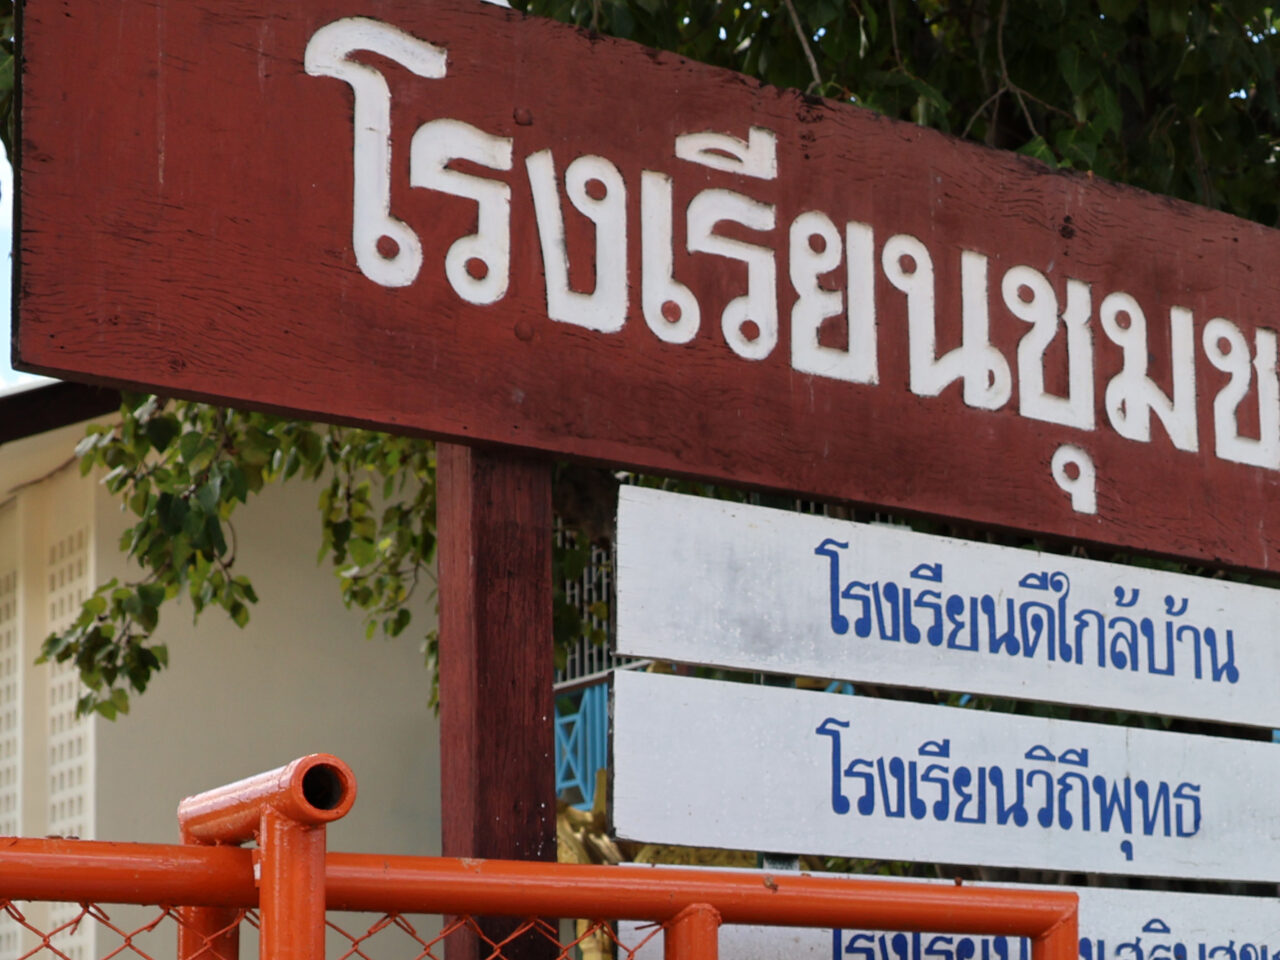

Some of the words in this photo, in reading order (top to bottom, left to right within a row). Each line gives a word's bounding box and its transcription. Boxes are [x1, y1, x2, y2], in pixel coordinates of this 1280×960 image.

[815, 539, 1240, 685] โรงเรียนดีใกล้บ้าน
[815, 717, 1202, 861] โรงเรียนวิถีพุทธ
